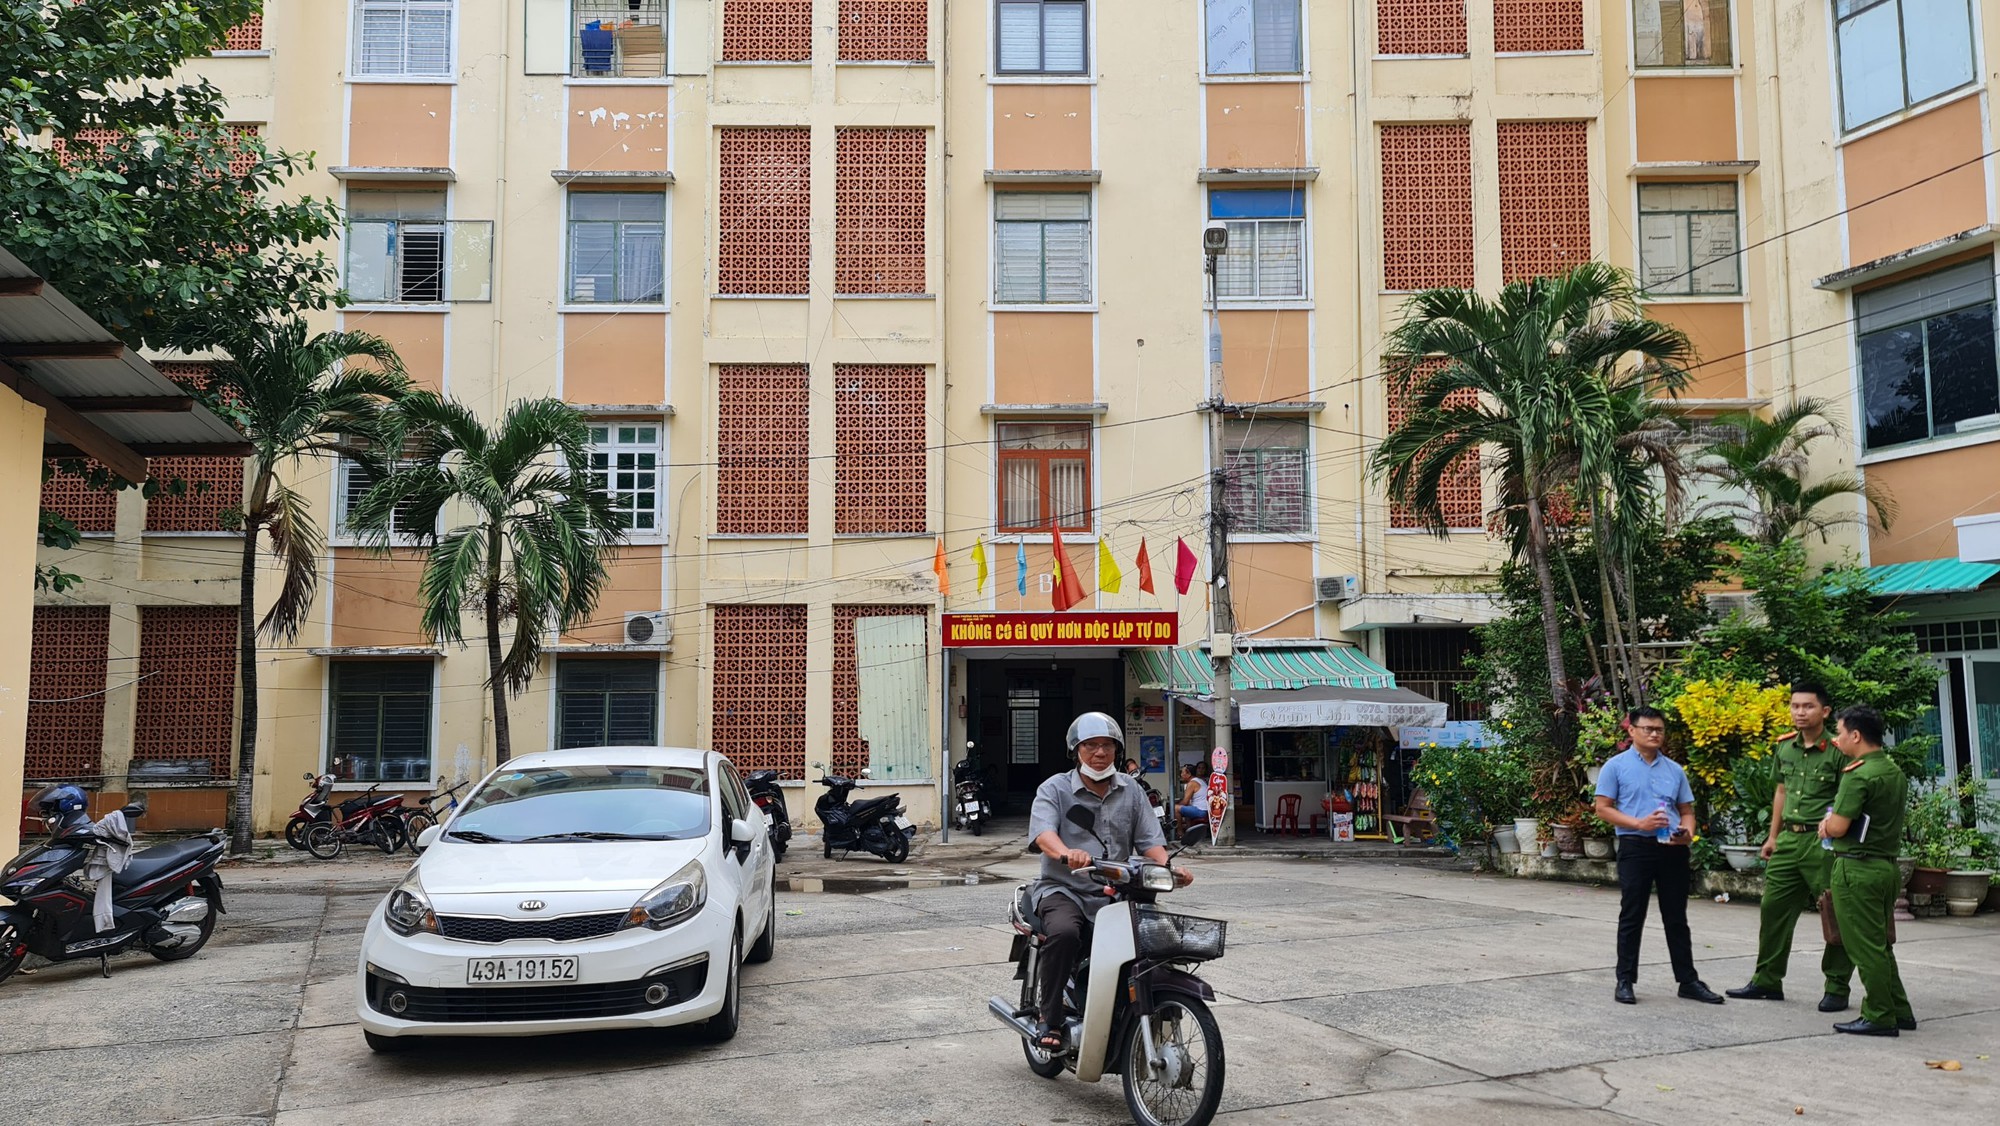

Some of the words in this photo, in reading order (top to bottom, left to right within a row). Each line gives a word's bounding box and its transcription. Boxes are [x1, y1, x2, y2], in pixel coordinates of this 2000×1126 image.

[951, 621, 992, 640] KHÔNG
[995, 620, 1012, 640] CÓ
[1014, 620, 1028, 640] GÌ
[1030, 620, 1054, 641] QUÝ
[1057, 620, 1082, 639] HƠN
[1084, 619, 1110, 641] ĐỘC
[1112, 619, 1134, 641] LẬP
[1136, 619, 1153, 641] TỰ
[1154, 622, 1171, 639] DO
[1387, 705, 1405, 714] 166
[521, 901, 542, 909] KIA
[472, 959, 574, 981] 43A-191.52
